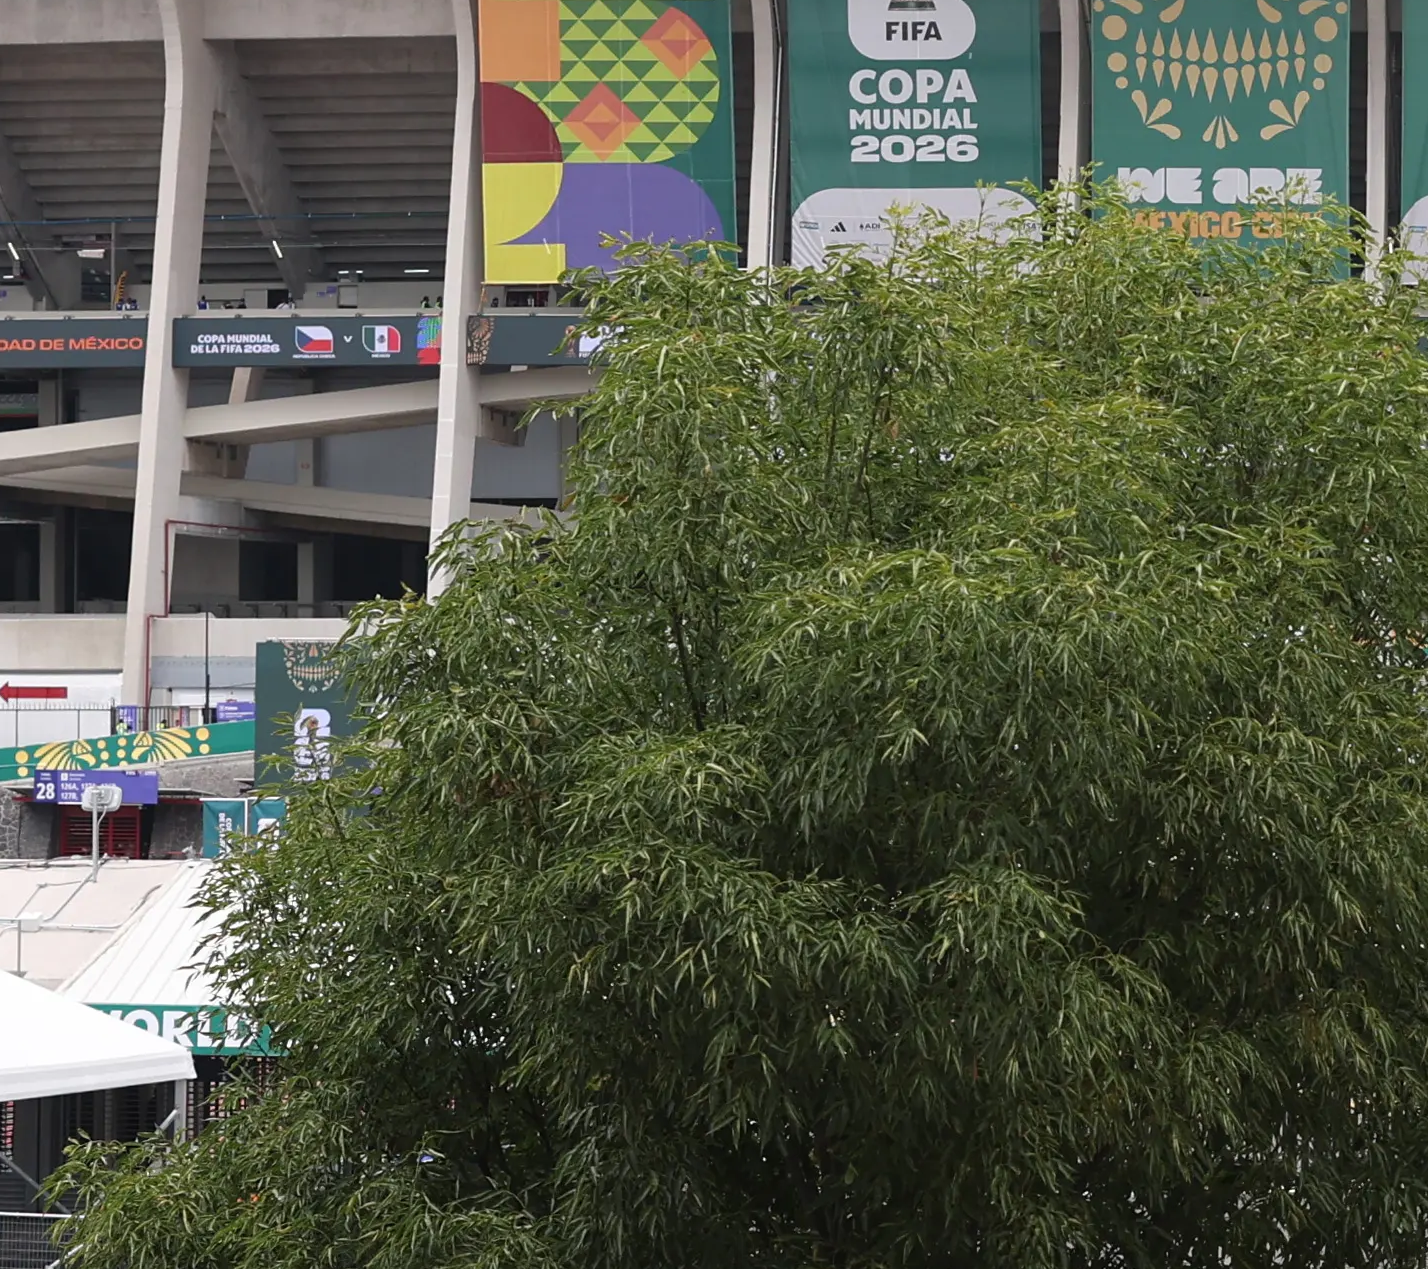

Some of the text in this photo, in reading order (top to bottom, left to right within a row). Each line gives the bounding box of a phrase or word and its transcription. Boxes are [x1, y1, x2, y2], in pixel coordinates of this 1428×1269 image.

[885, 21, 942, 42] FIFA
[848, 68, 978, 105] COPA
[849, 108, 979, 131] MUNDIAL
[850, 134, 980, 164] 2026
[1118, 167, 1323, 205] WE ARE
[39, 338, 65, 351] DE
[69, 335, 144, 350] MÉXICO
[190, 344, 280, 354] DE LA FIFA 2026
[197, 334, 273, 343] COPA MUNDIAL
[35, 782, 56, 800] 28
